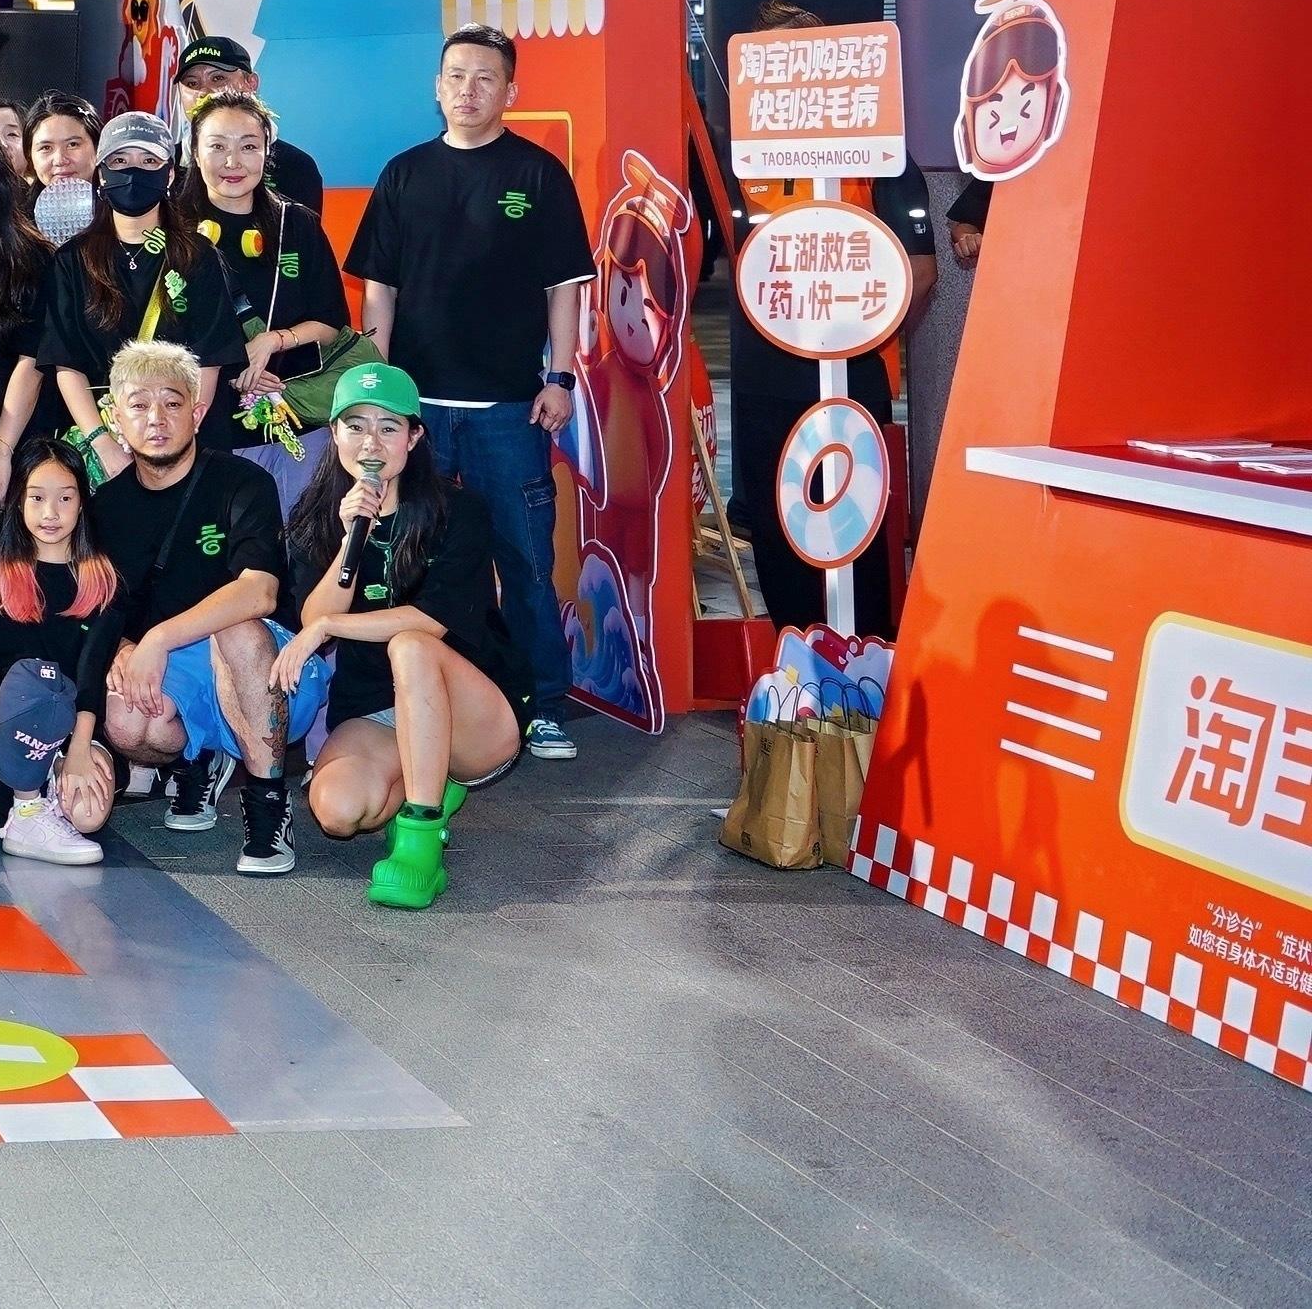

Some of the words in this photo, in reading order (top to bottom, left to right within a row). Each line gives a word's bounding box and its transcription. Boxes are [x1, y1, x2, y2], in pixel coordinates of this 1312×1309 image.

[199, 47, 221, 57] MAN
[736, 33, 889, 85] 淘宝闪购买药
[748, 84, 880, 132] 快到没毛病
[761, 149, 871, 166] TAOBAOSHANGOU
[769, 231, 872, 273] 江湖救急
[757, 280, 887, 321] 「药」快一步
